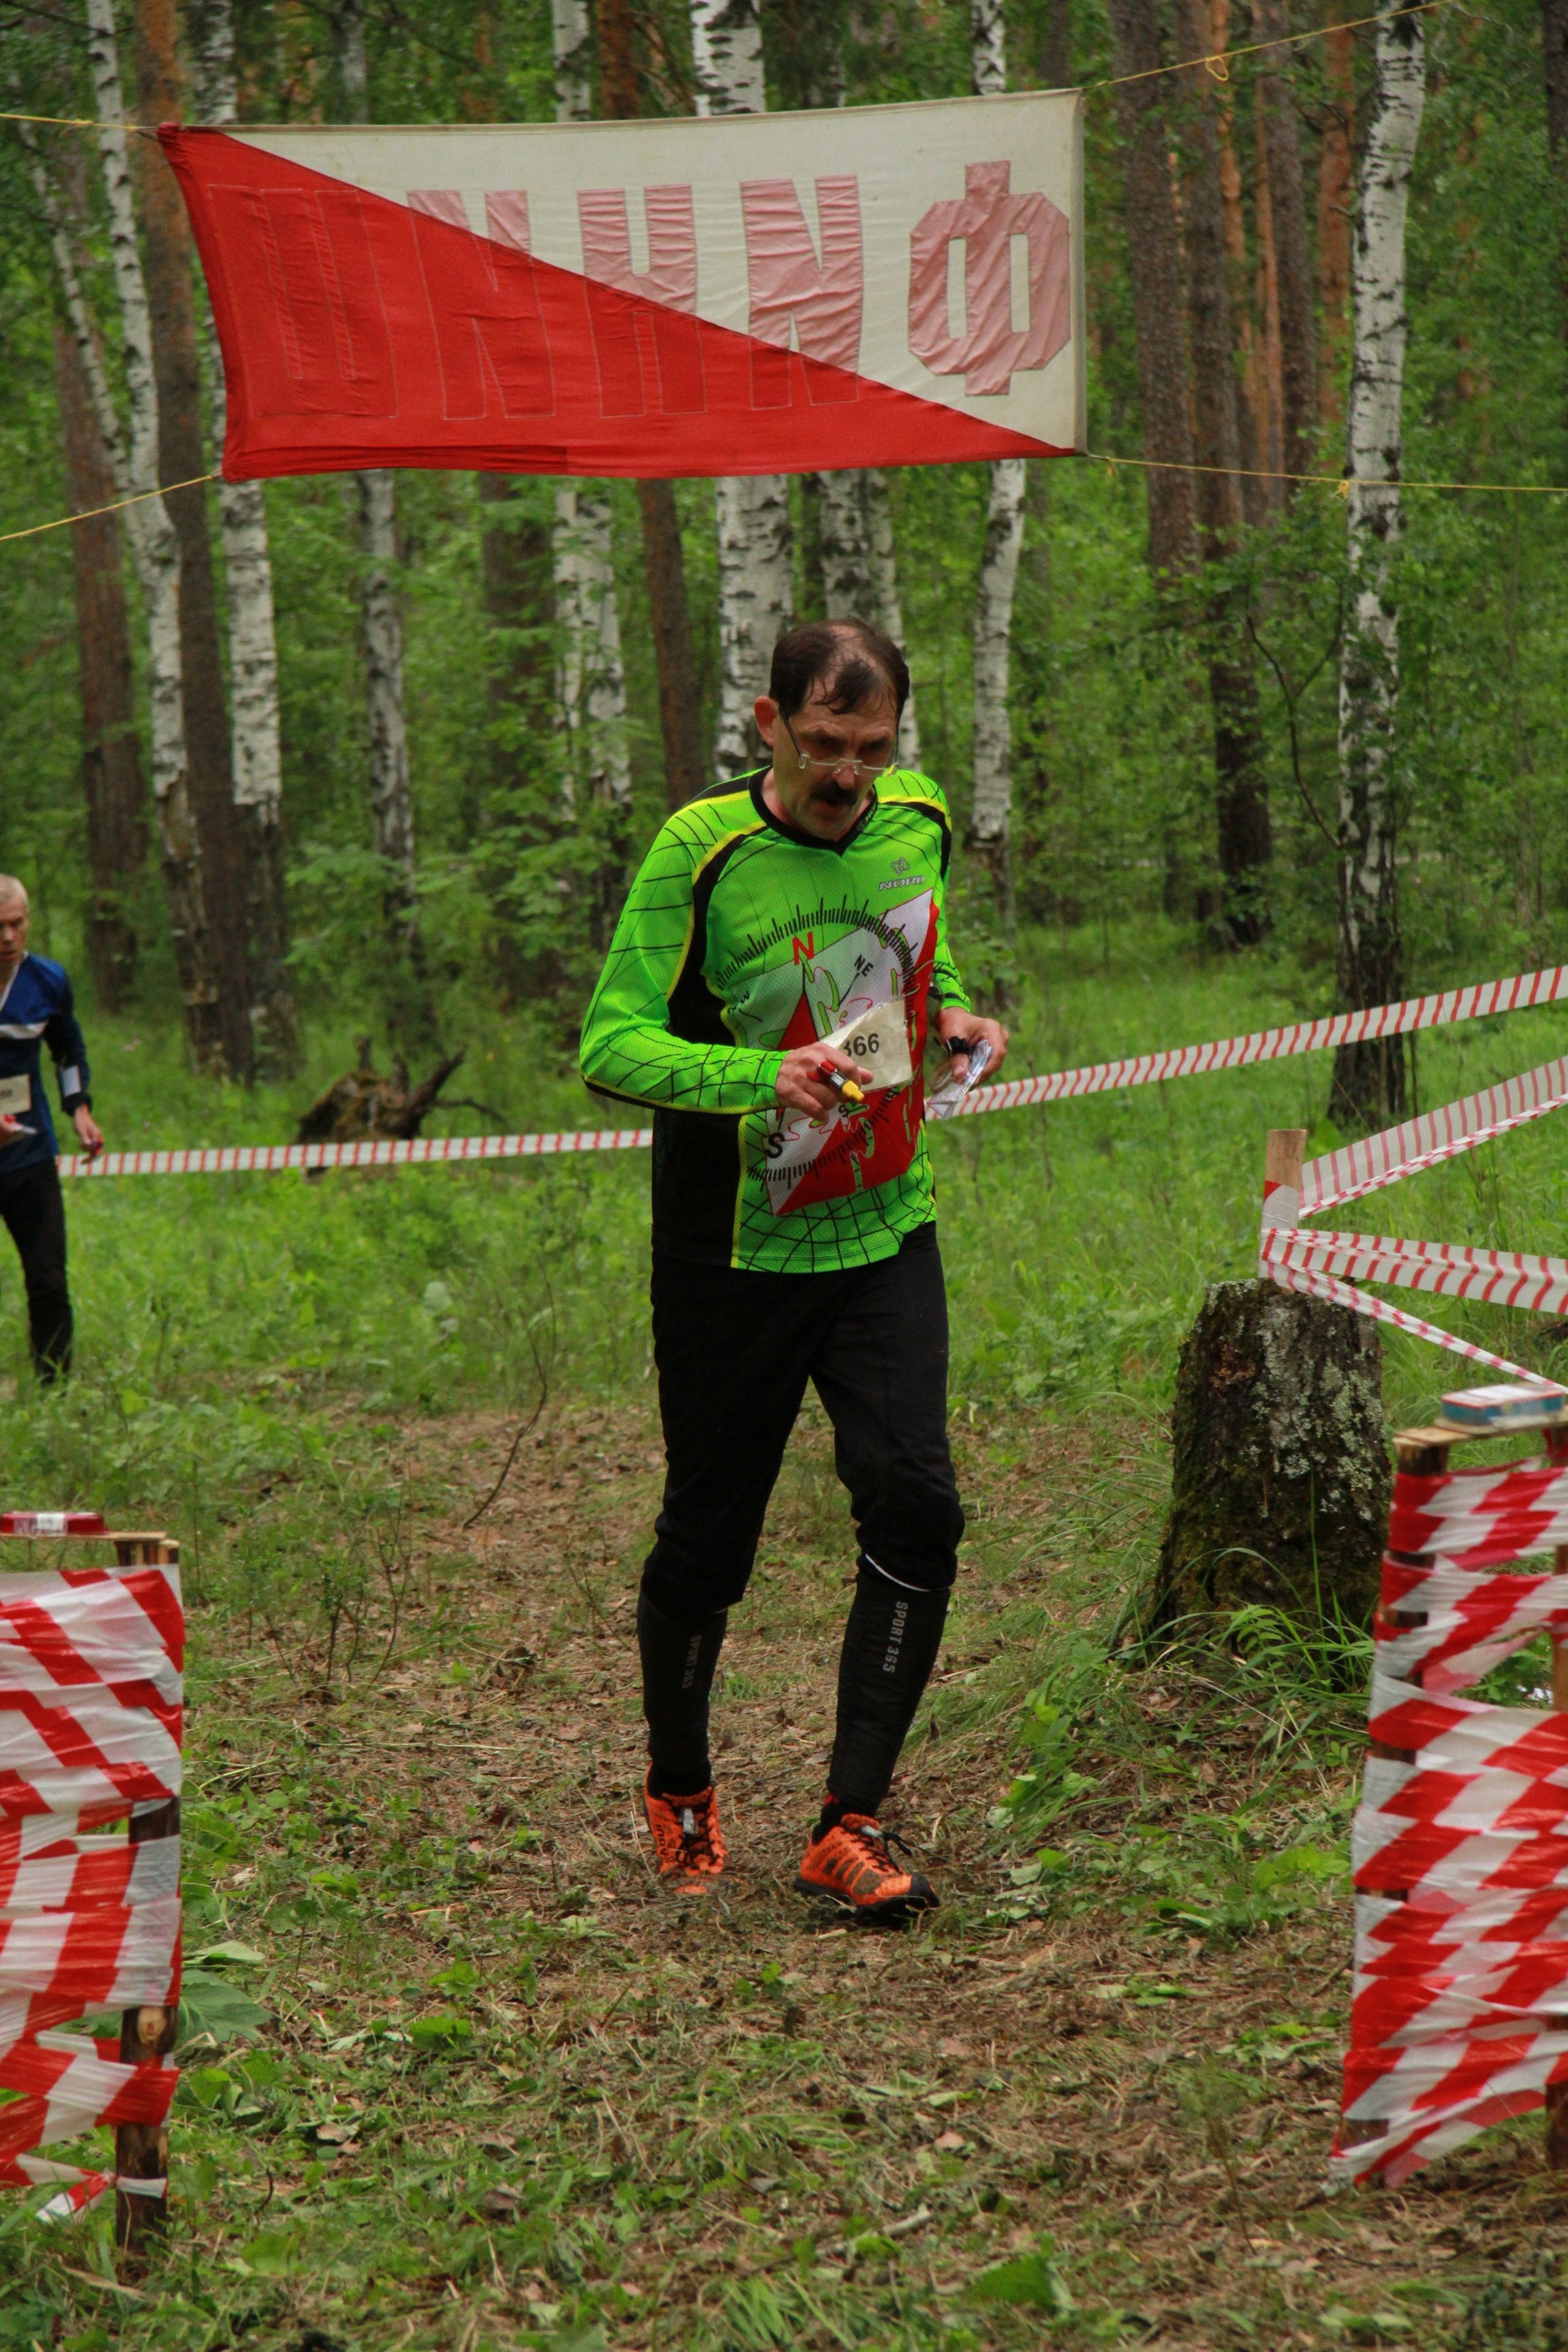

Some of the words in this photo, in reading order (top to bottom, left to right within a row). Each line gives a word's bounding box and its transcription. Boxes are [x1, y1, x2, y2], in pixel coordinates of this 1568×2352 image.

[792, 931, 815, 965] N
[854, 954, 873, 977] NE
[766, 1132, 785, 1159] S
[889, 1601, 908, 1644] SPORT
[883, 1646, 899, 1673] 365
